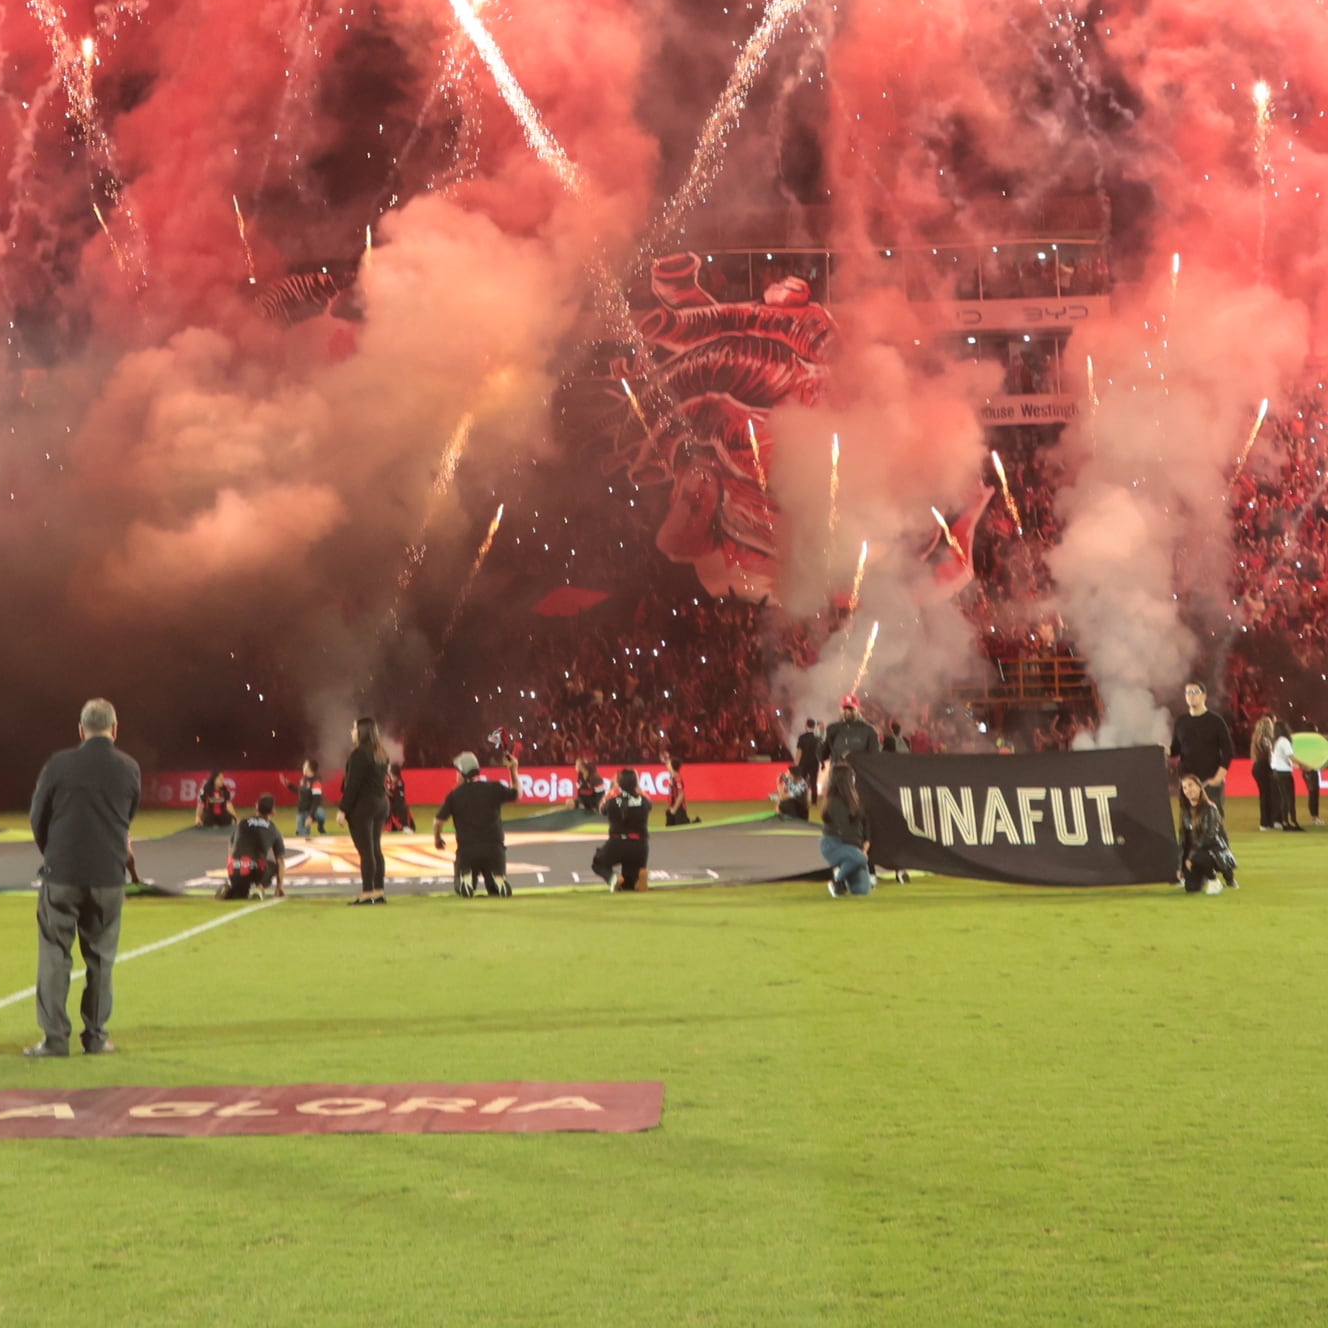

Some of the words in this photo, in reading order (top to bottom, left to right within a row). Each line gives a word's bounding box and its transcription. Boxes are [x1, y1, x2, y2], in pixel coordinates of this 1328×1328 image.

[520, 773, 573, 802] Roja
[899, 785, 1118, 847] UNAFUT
[129, 1095, 604, 1118] GLORIA
